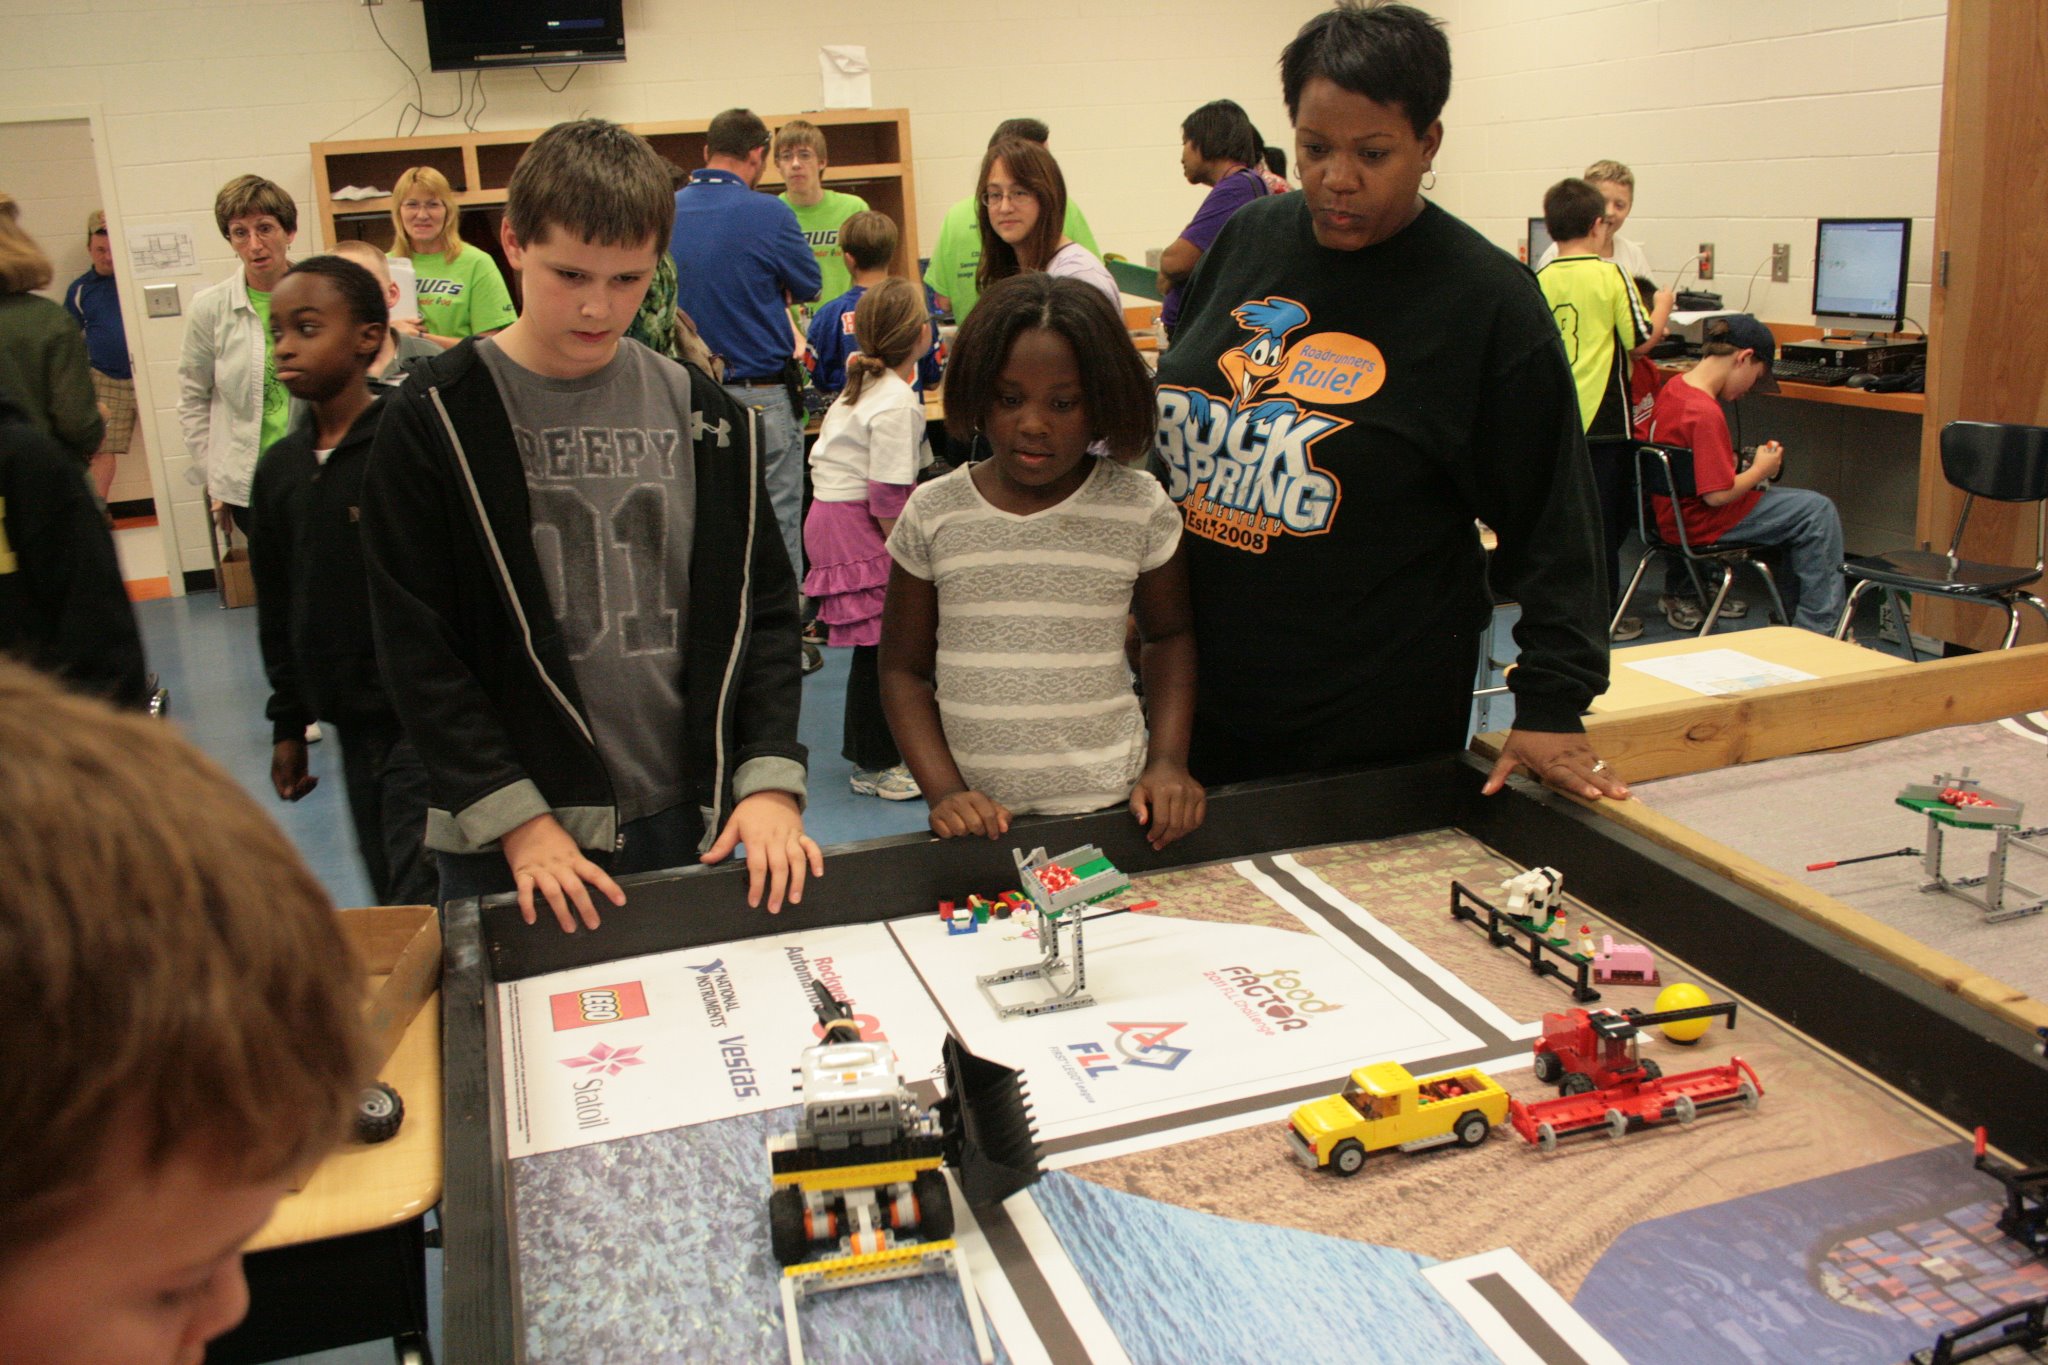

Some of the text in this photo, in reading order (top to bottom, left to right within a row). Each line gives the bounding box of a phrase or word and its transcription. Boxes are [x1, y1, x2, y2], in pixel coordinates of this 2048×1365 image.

[1288, 360, 1363, 396] Rule!
[1300, 345, 1376, 372] Roadrunners
[1216, 522, 1265, 550] 2008
[580, 988, 622, 1022] LEGO
[695, 974, 727, 1028] INSTRUMENTS
[714, 970, 740, 1012] NATIONAL
[1202, 970, 1229, 988] 2011
[1233, 999, 1276, 1037] Challenge
[1219, 966, 1309, 1032] FACTOR
[1253, 969, 1345, 1013] food
[718, 1034, 760, 1099] Vestas
[1066, 1041, 1120, 1080] FLL
[572, 1078, 610, 1130] Statoil
